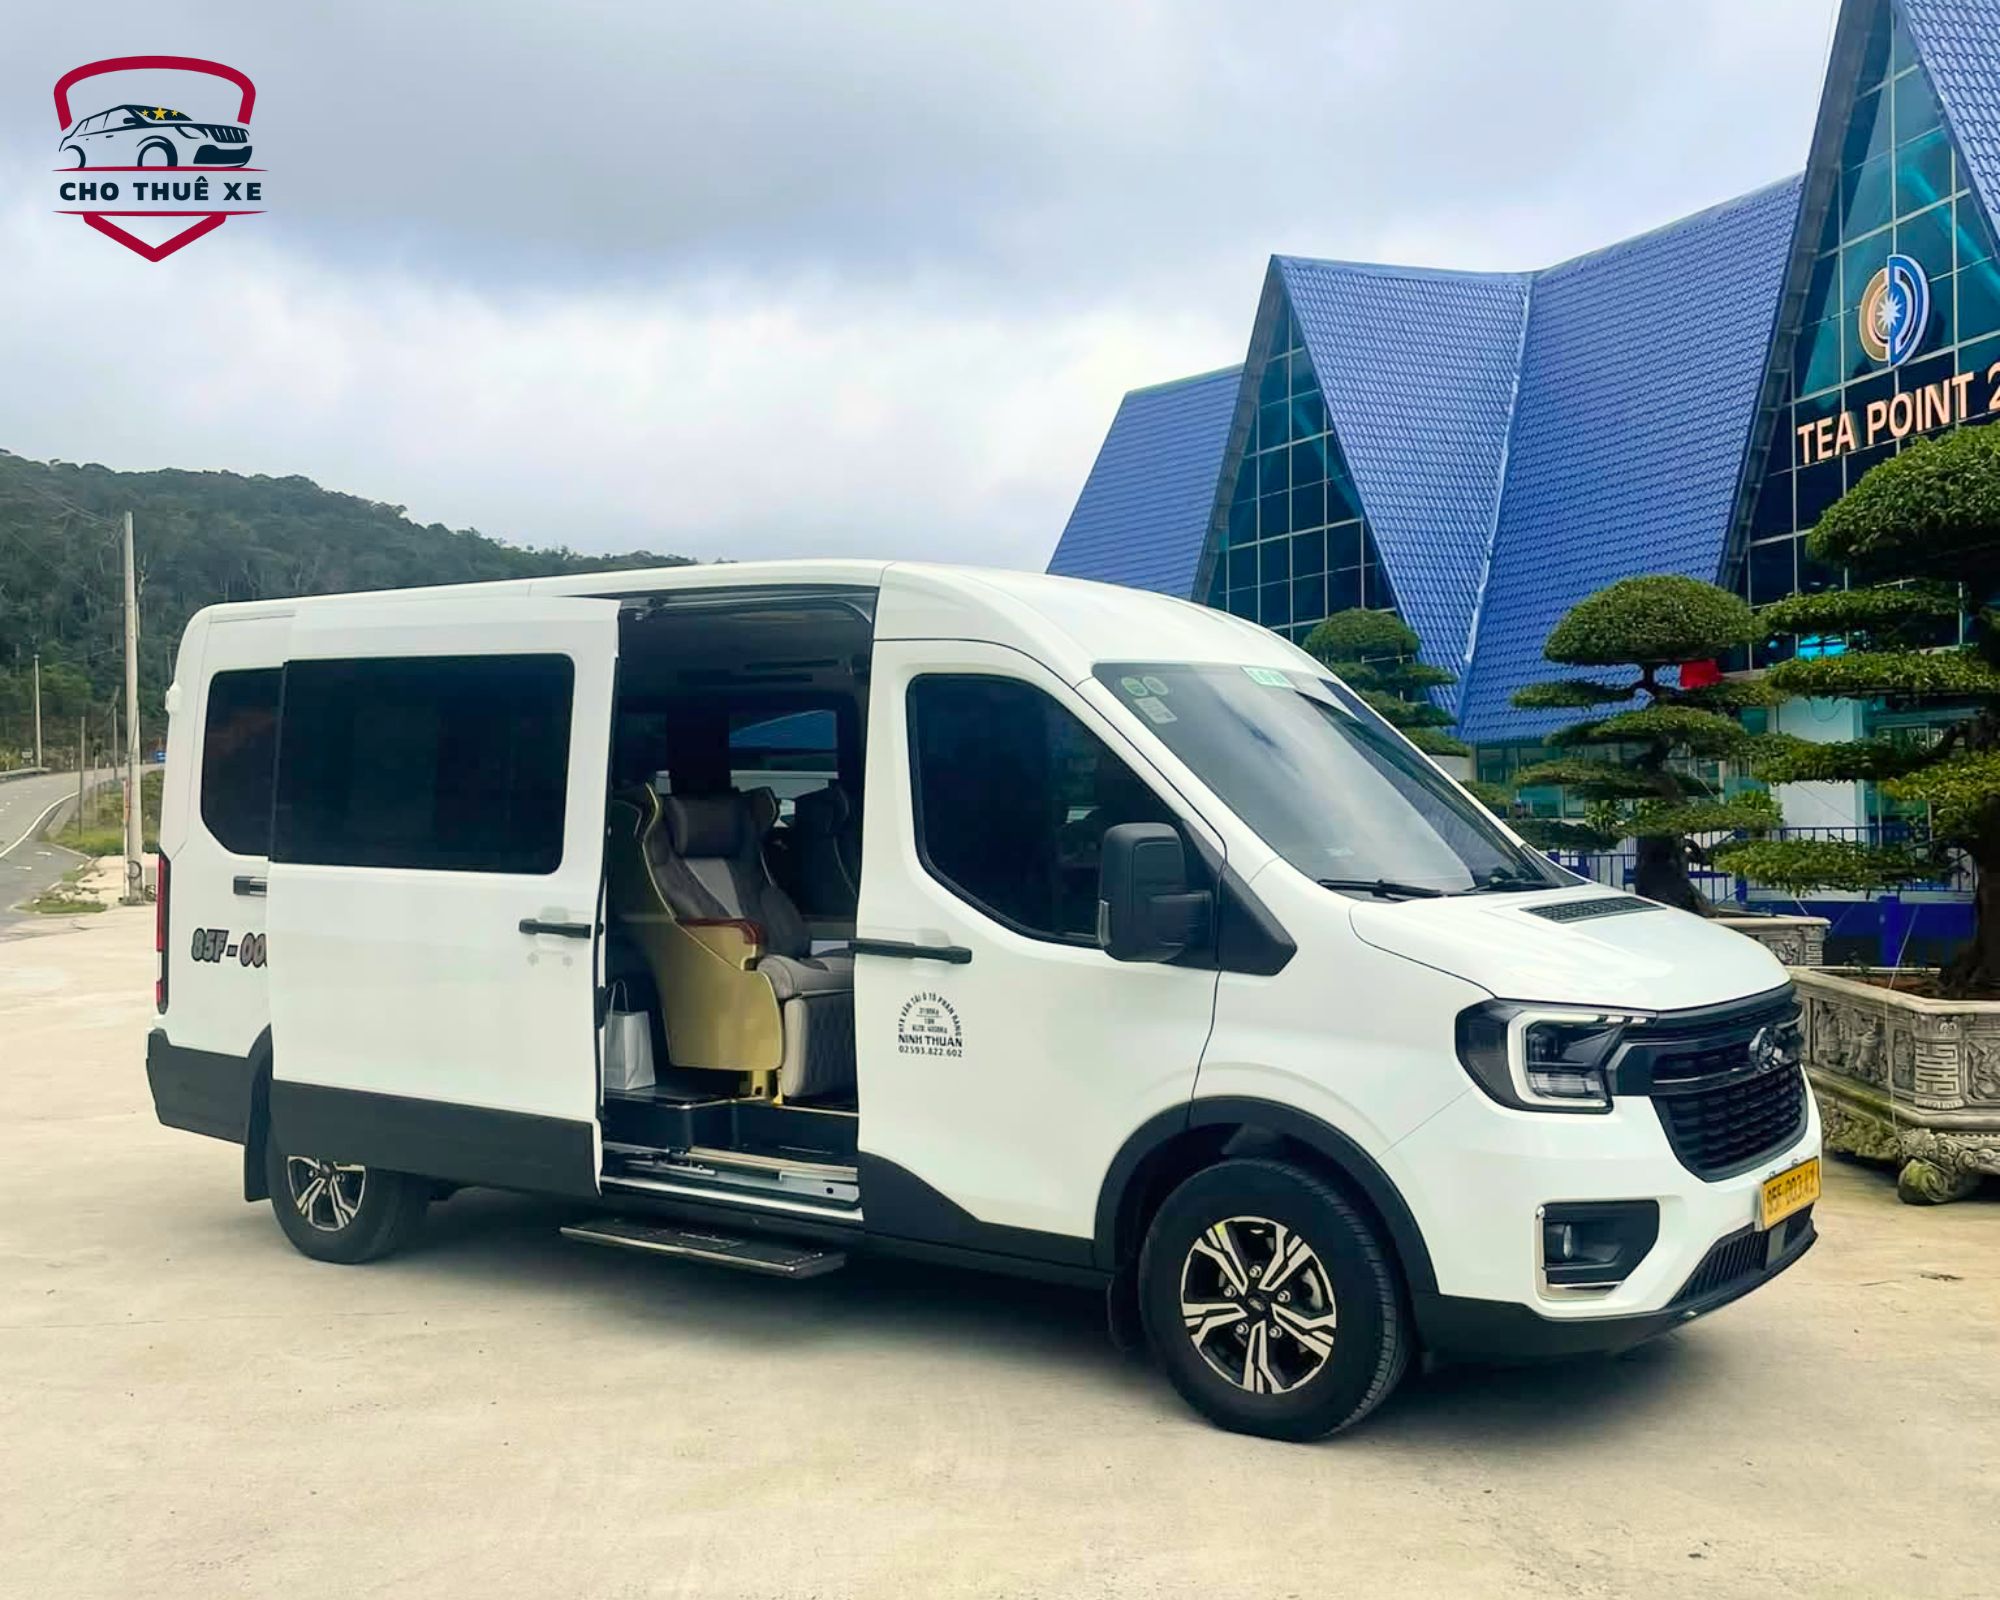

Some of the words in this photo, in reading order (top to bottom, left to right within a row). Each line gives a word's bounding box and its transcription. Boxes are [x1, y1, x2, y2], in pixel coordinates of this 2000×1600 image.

[1797, 410, 1856, 464] TEA
[1866, 372, 1974, 446] POINT
[898, 1034, 923, 1045] NINH
